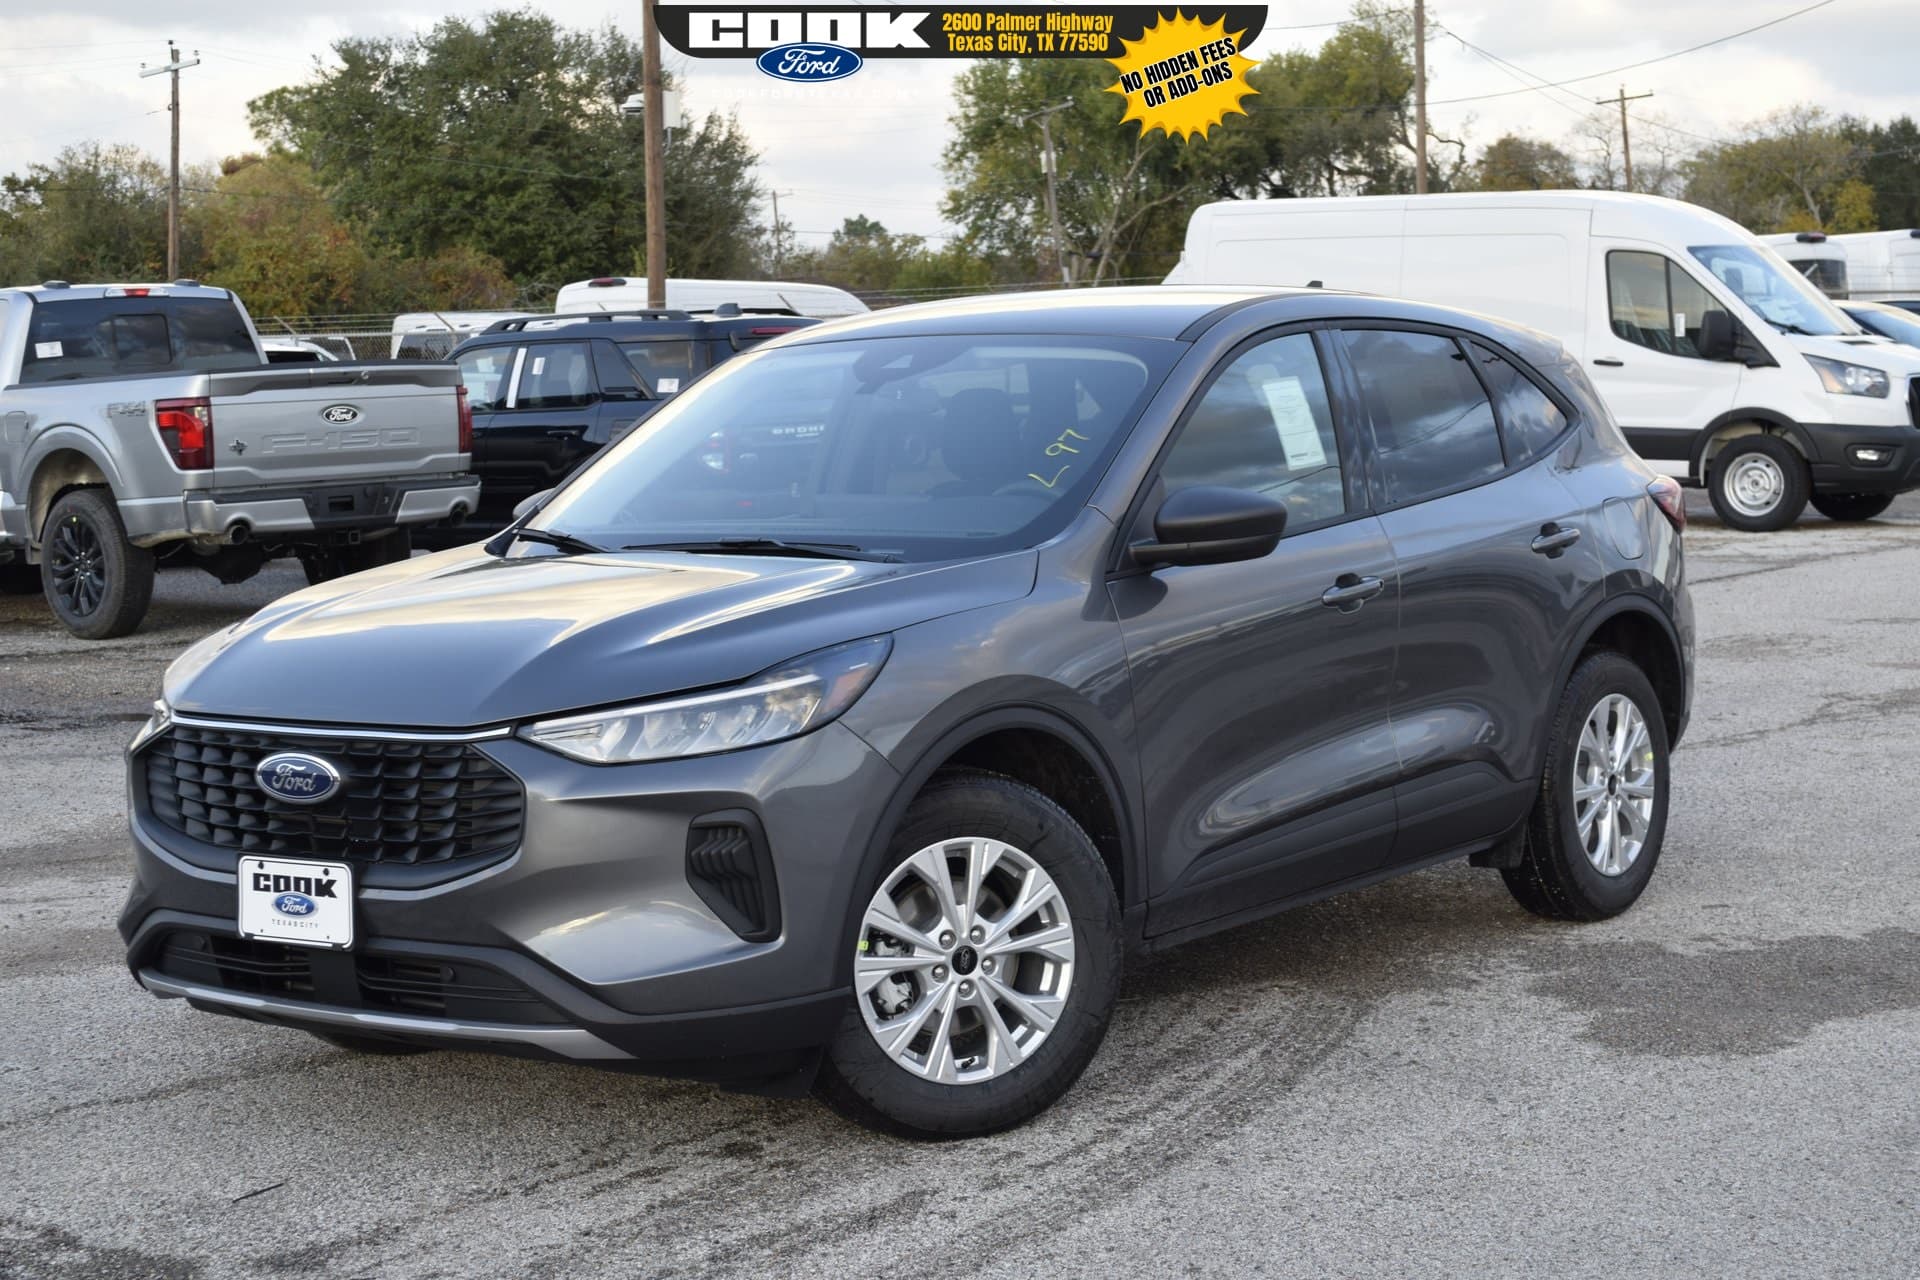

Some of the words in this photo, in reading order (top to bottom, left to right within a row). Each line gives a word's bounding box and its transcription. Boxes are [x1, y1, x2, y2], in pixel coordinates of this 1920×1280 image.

[262, 427, 421, 454] F-150
[271, 763, 317, 793] Ford
[253, 872, 338, 899] COOK
[281, 896, 308, 914] Ford
